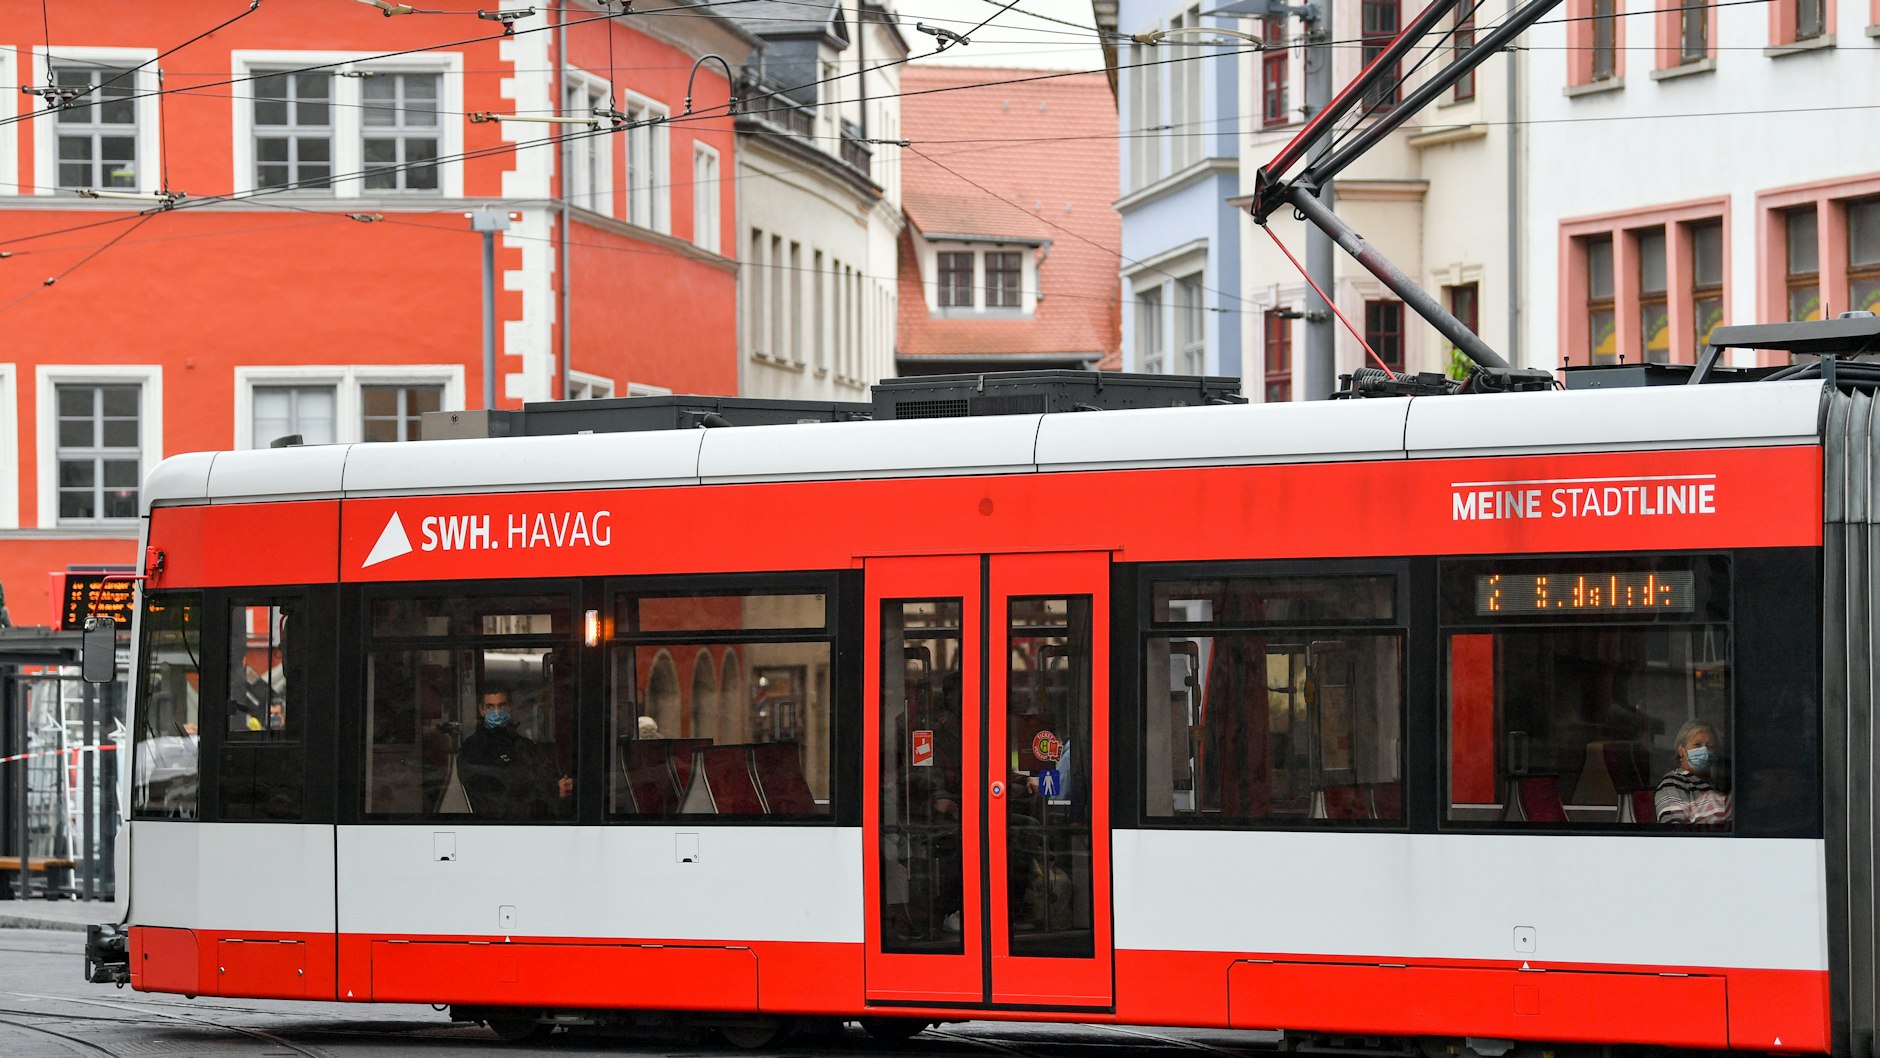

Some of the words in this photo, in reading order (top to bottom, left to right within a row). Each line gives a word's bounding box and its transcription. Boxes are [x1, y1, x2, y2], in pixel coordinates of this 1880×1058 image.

[1452, 489, 1542, 521] MEINE
[1551, 484, 1716, 518] STADTLINIE
[420, 514, 499, 552] SWH.
[507, 510, 612, 549] HAVAG
